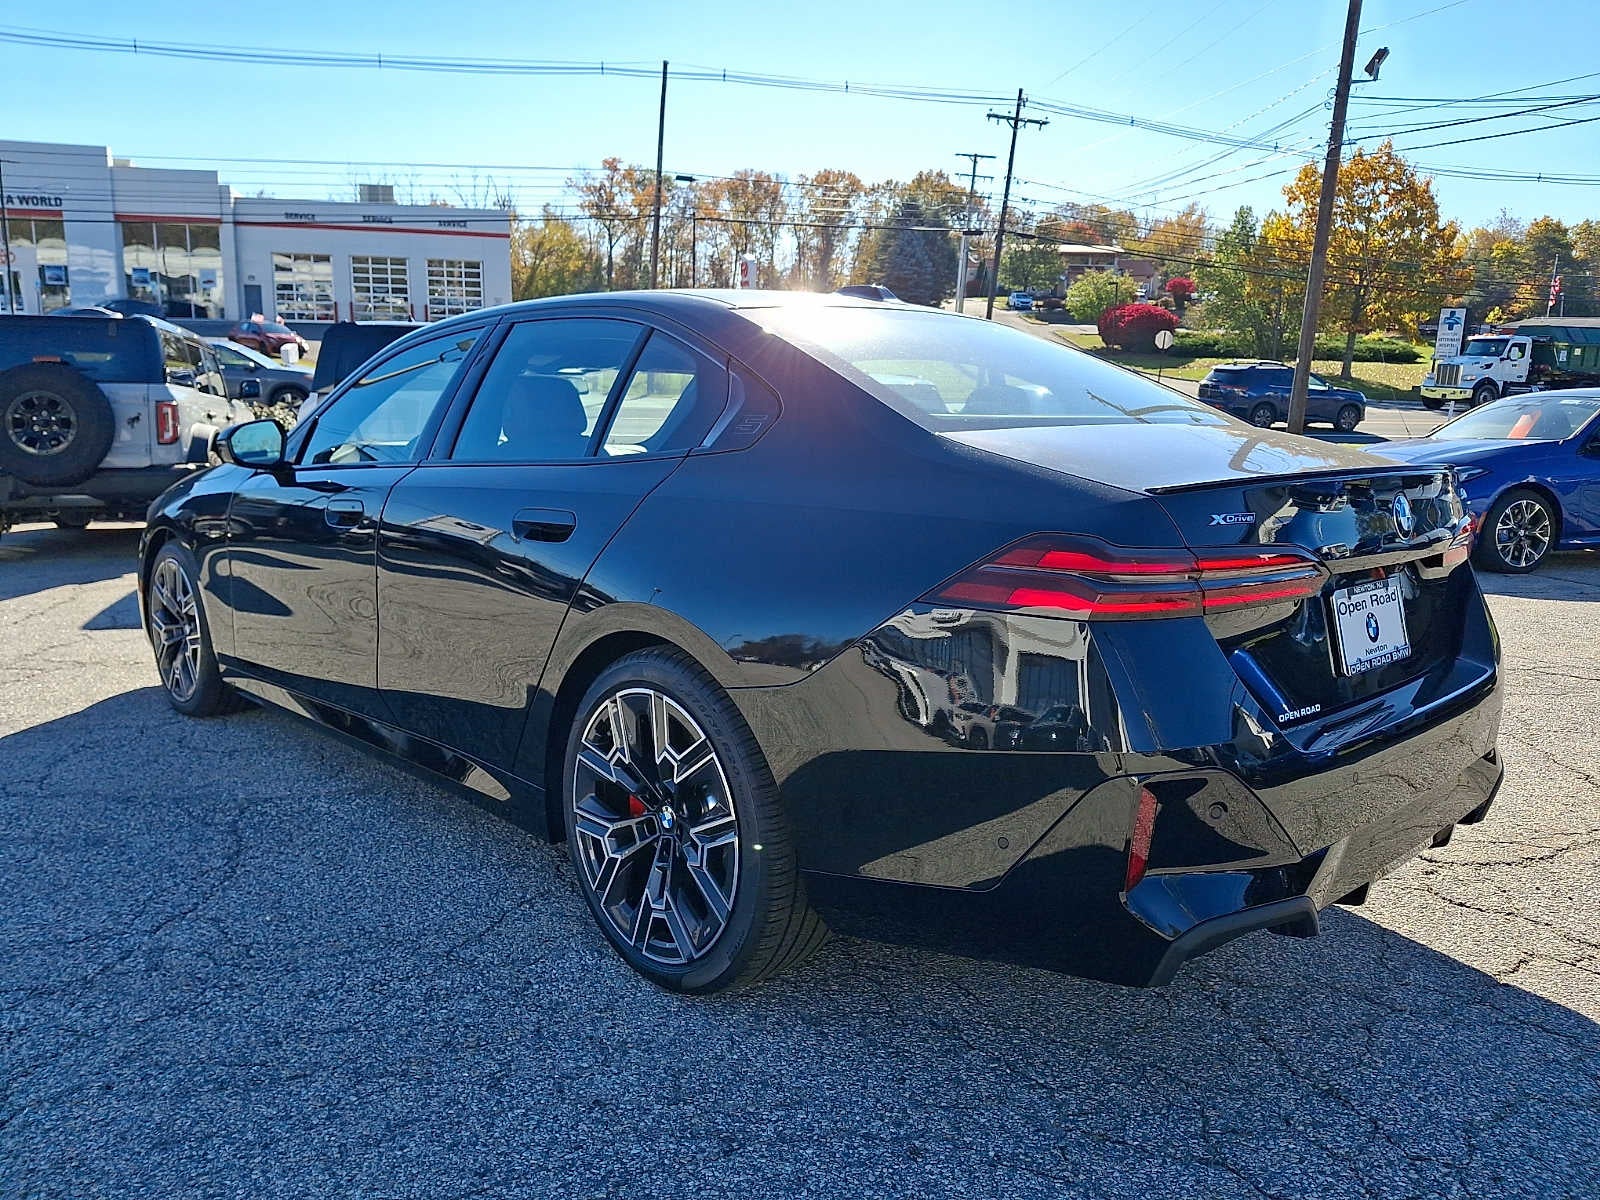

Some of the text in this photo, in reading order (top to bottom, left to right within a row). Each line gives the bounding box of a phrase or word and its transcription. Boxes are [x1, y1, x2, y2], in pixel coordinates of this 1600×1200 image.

[17, 194, 63, 207] WORLD
[1338, 590, 1397, 617] Open Road
[1365, 643, 1388, 656] Newton
[1350, 648, 1409, 674] OPEN ROAD BMW
[1278, 703, 1321, 723] OPEN ROAD
